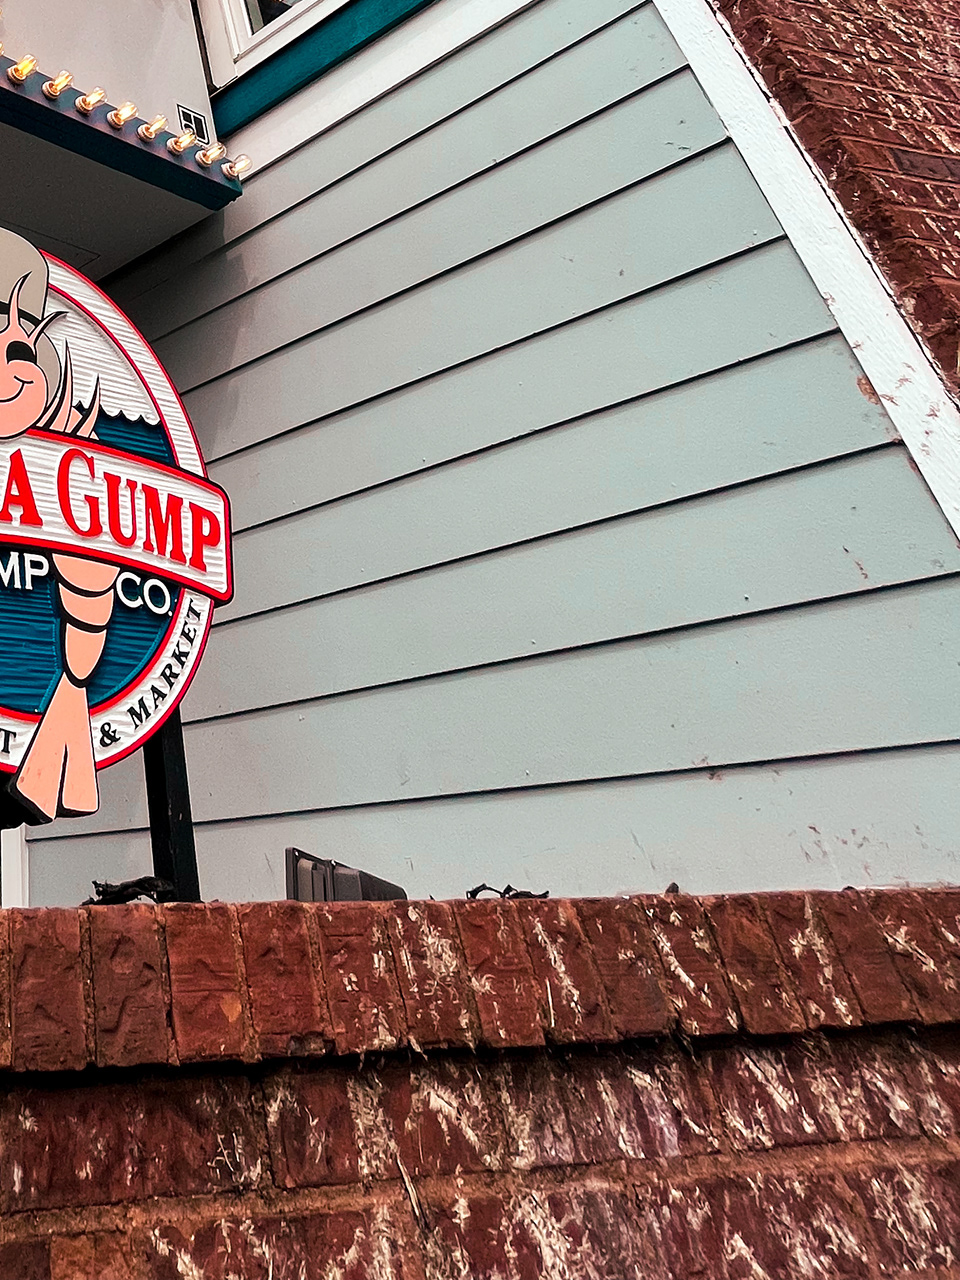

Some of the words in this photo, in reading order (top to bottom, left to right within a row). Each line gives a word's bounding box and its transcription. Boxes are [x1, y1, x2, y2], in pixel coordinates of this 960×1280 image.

[56, 448, 222, 573] GUMP
[115, 571, 173, 617] CO.
[99, 722, 121, 748] &
[126, 599, 202, 730] MARKET
